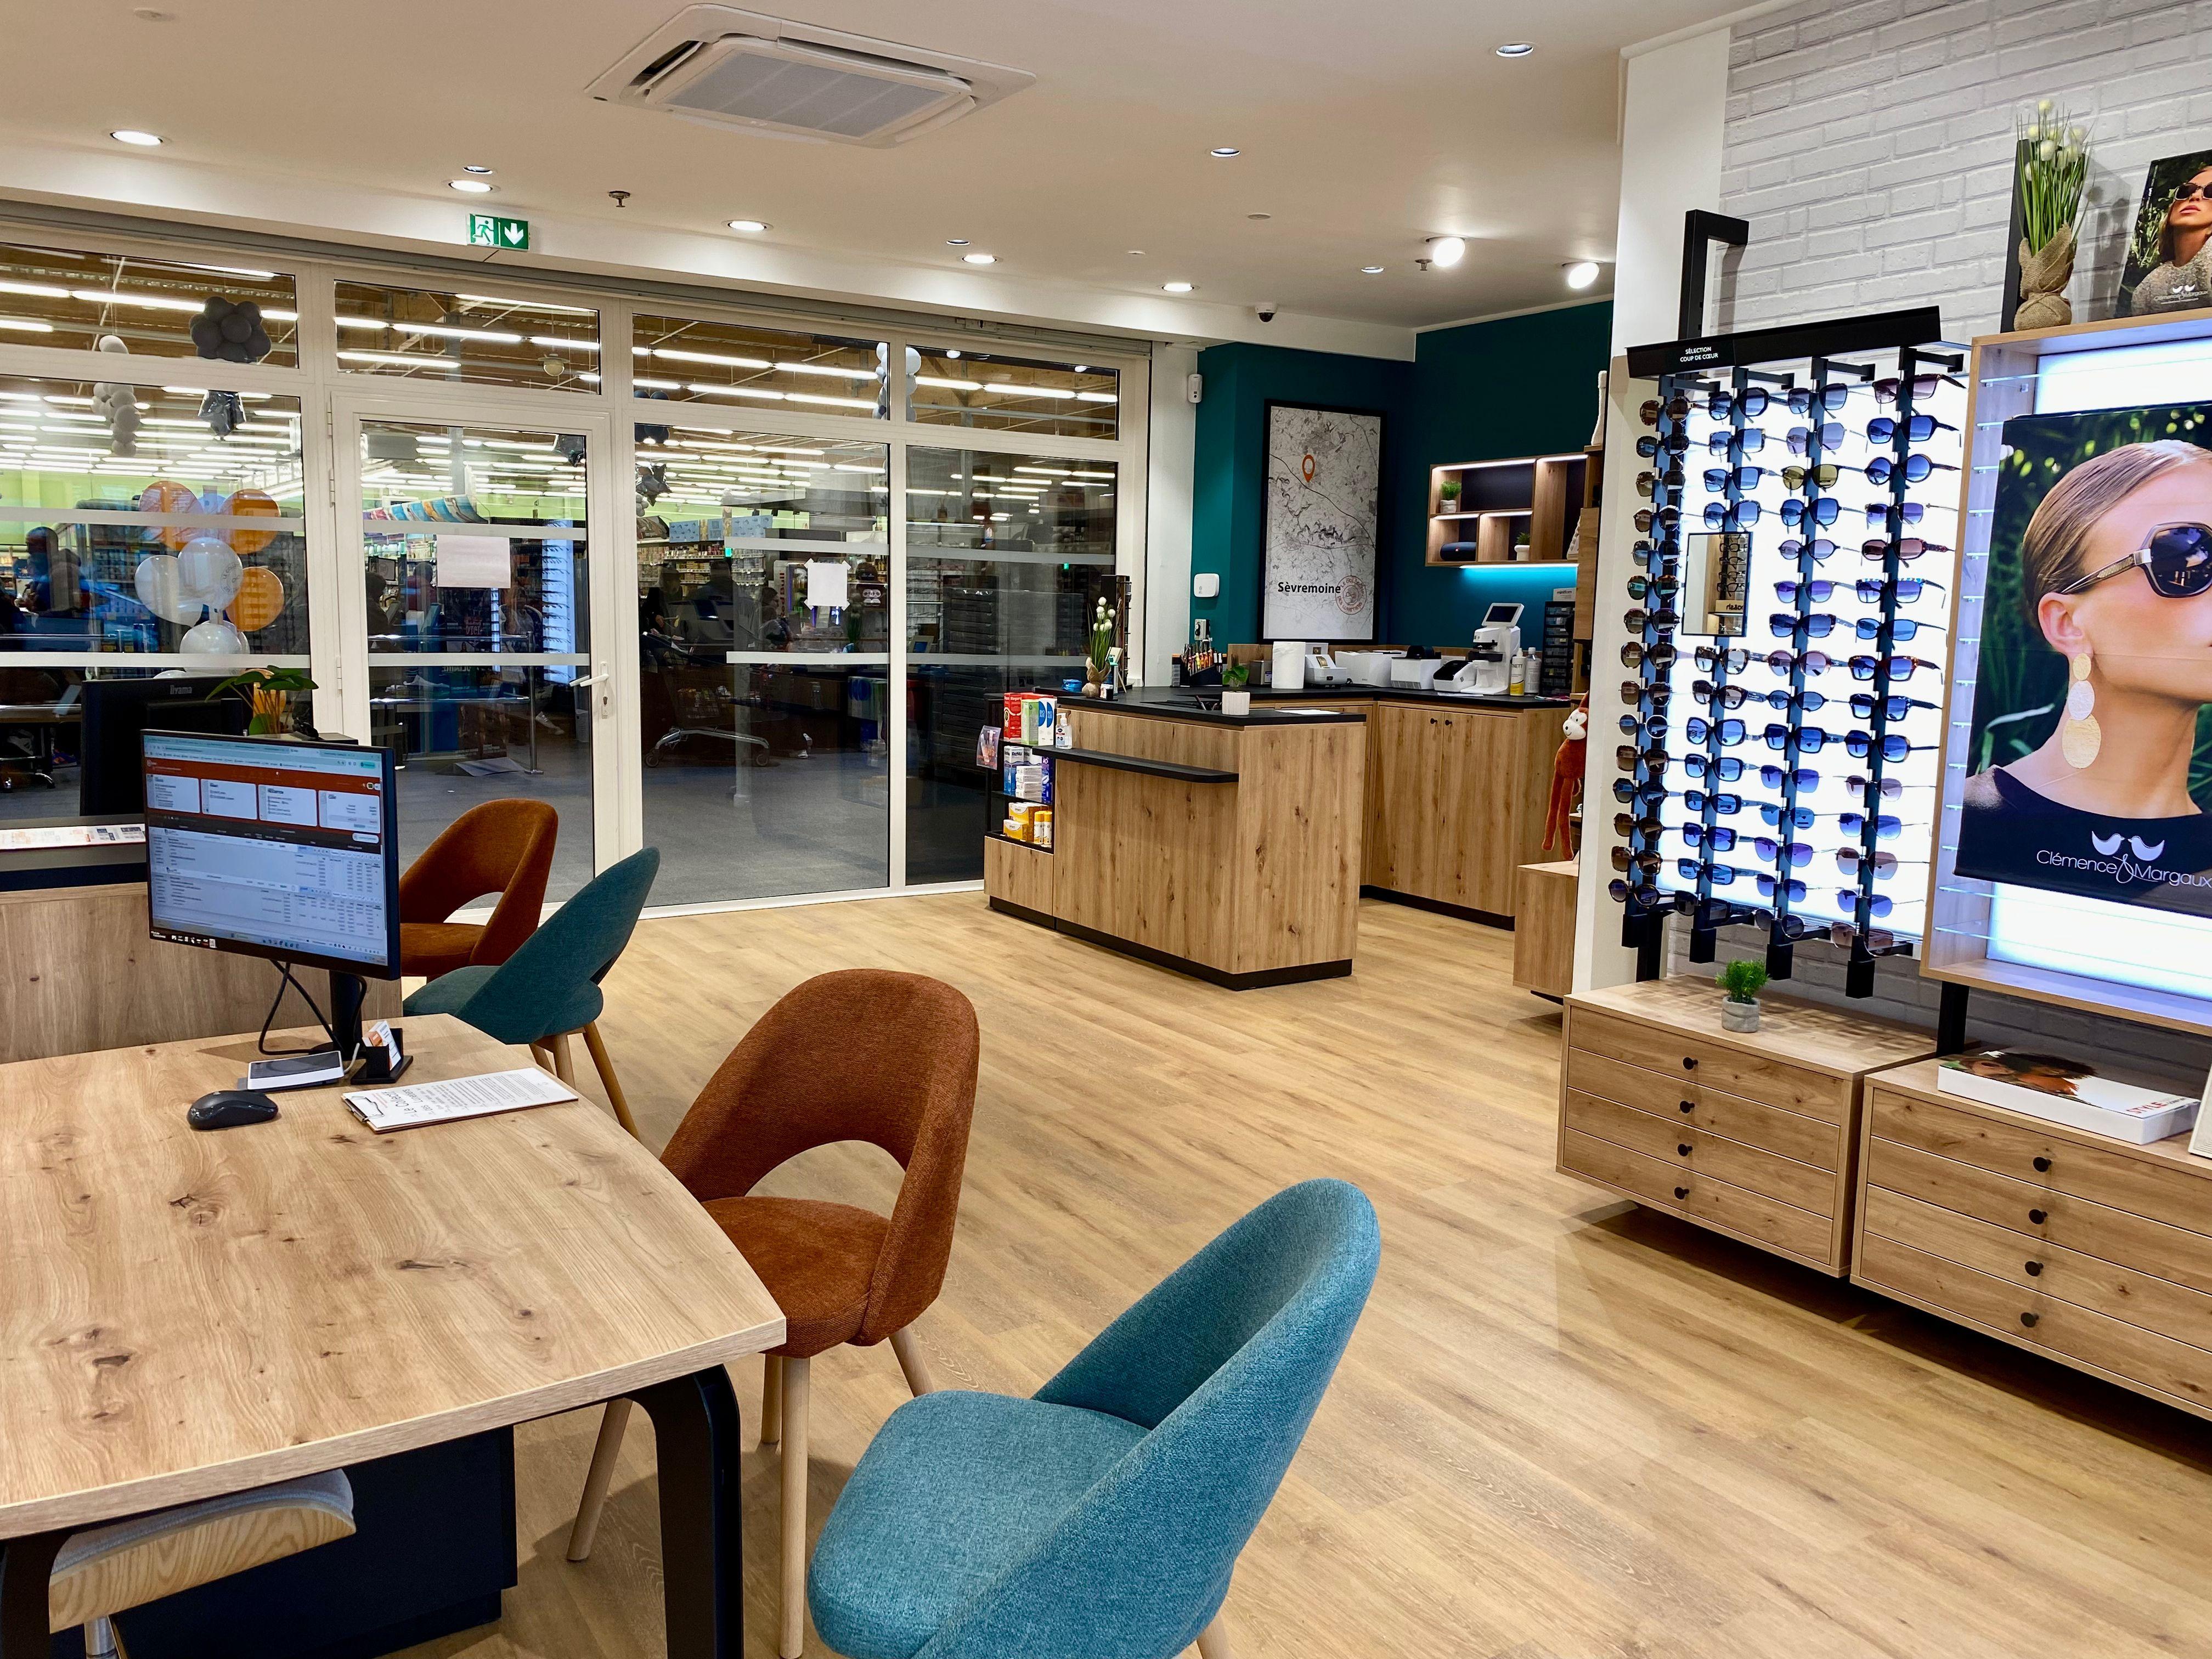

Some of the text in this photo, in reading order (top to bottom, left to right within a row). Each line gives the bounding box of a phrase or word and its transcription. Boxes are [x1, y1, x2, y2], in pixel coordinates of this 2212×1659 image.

[1685, 346, 1712, 354] SÉLECTION
[1278, 582, 1341, 594] Sèvremoine
[2036, 849, 2117, 874] Clémence
[2134, 863, 2212, 889] Margaux
[2126, 1102, 2167, 1114] STYLE
